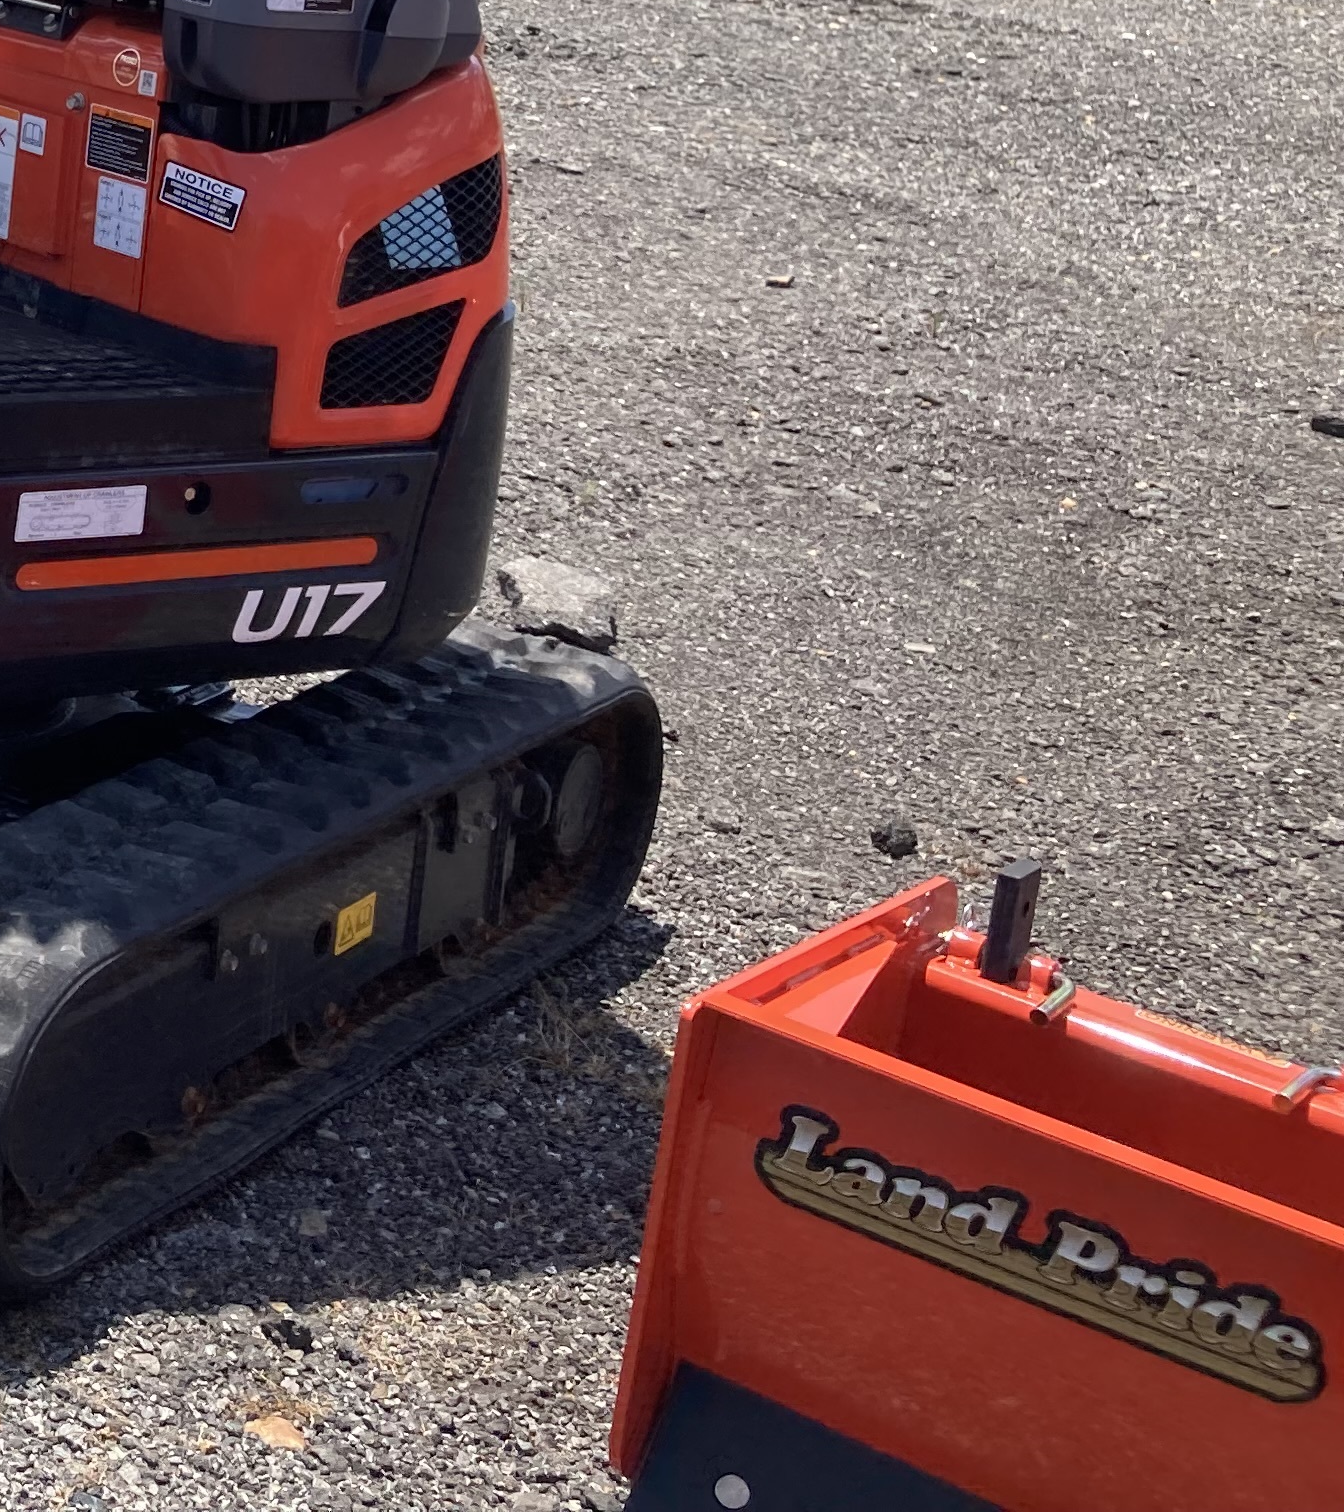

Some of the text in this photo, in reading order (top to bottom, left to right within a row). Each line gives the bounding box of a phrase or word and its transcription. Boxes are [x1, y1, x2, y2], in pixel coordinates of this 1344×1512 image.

[174, 168, 234, 199] NOTICE
[232, 580, 387, 644] U17
[771, 1114, 1312, 1371] Land Pride
